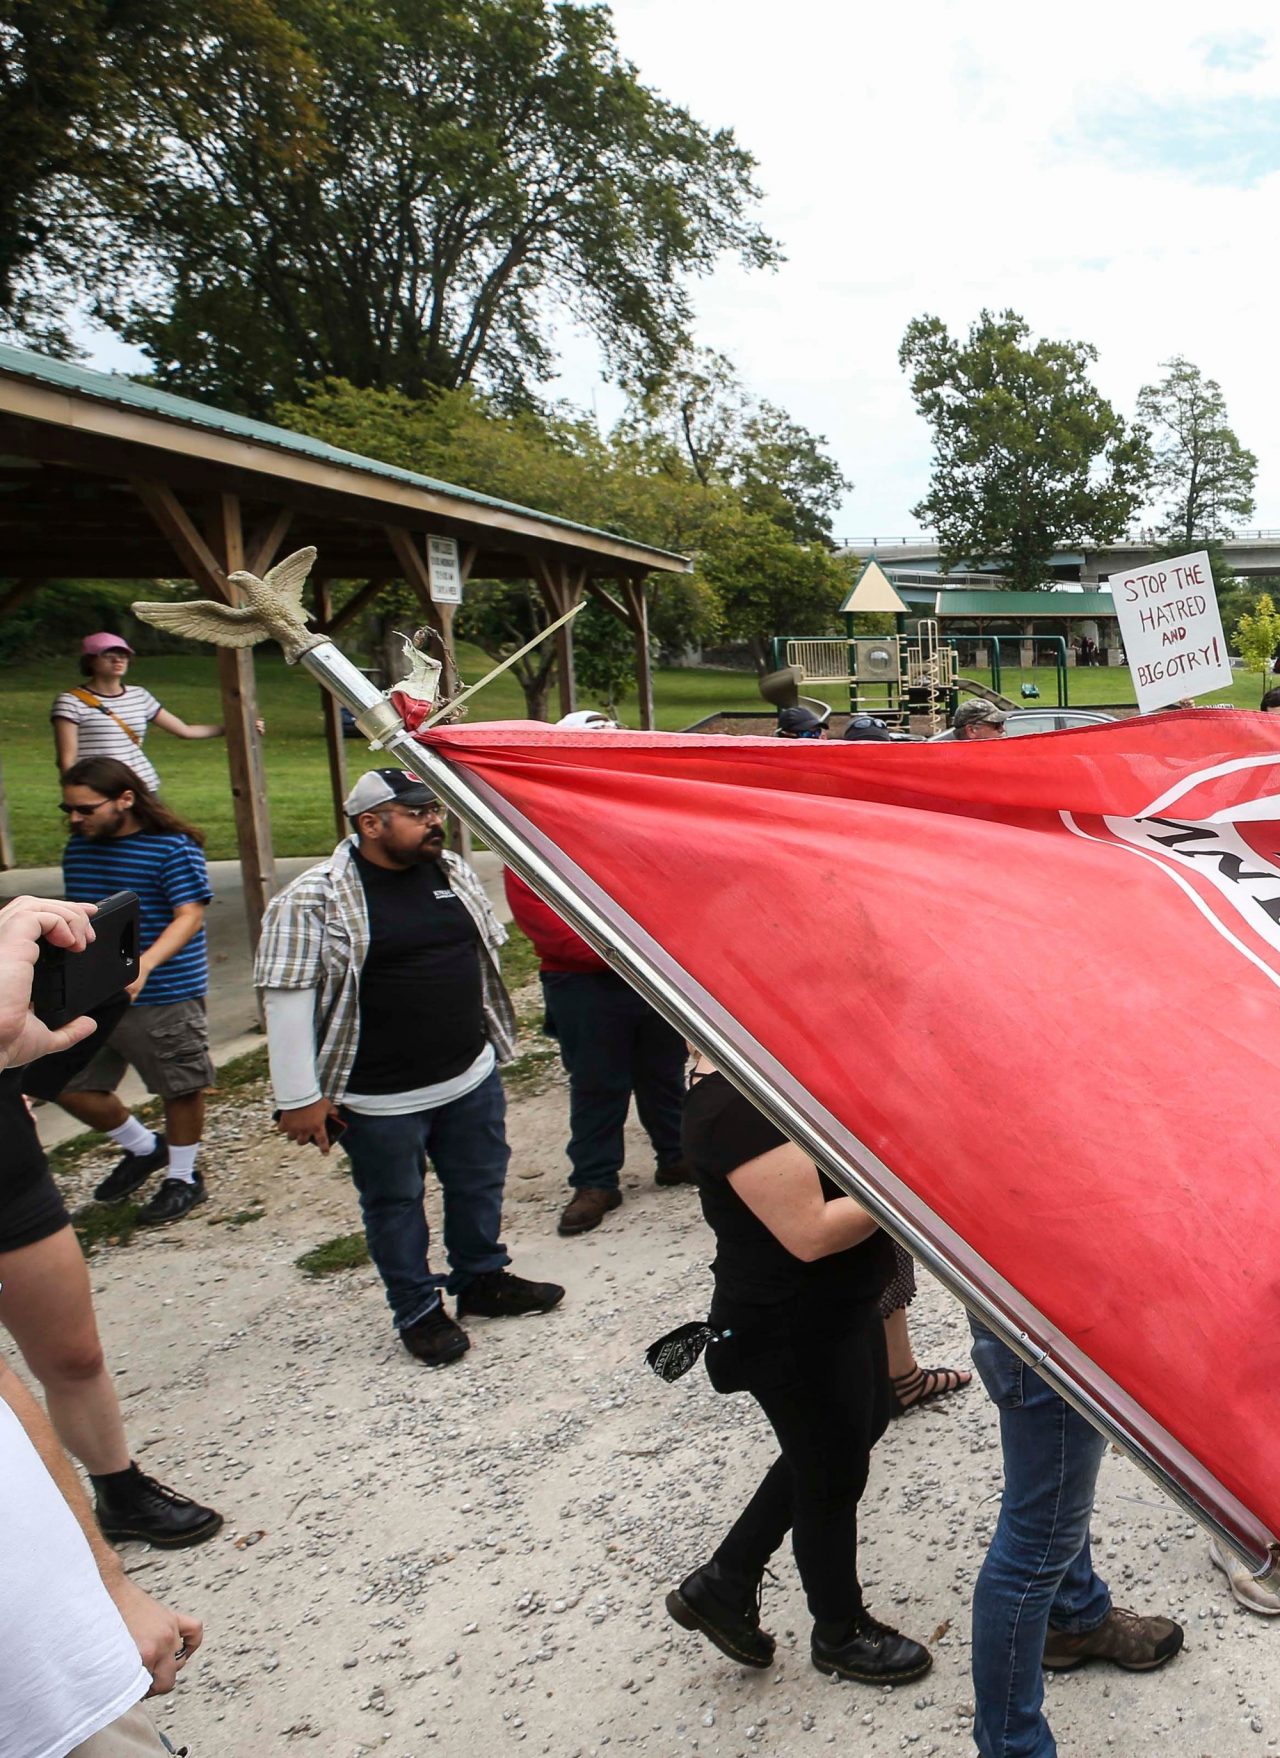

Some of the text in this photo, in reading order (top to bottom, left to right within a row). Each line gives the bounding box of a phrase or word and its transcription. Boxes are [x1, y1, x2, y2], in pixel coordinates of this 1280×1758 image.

[1124, 564, 1205, 602] STOP THE
[1139, 595, 1206, 633] HATRED
[1162, 626, 1187, 647] AND
[1137, 636, 1222, 687] BIGOTRY!
